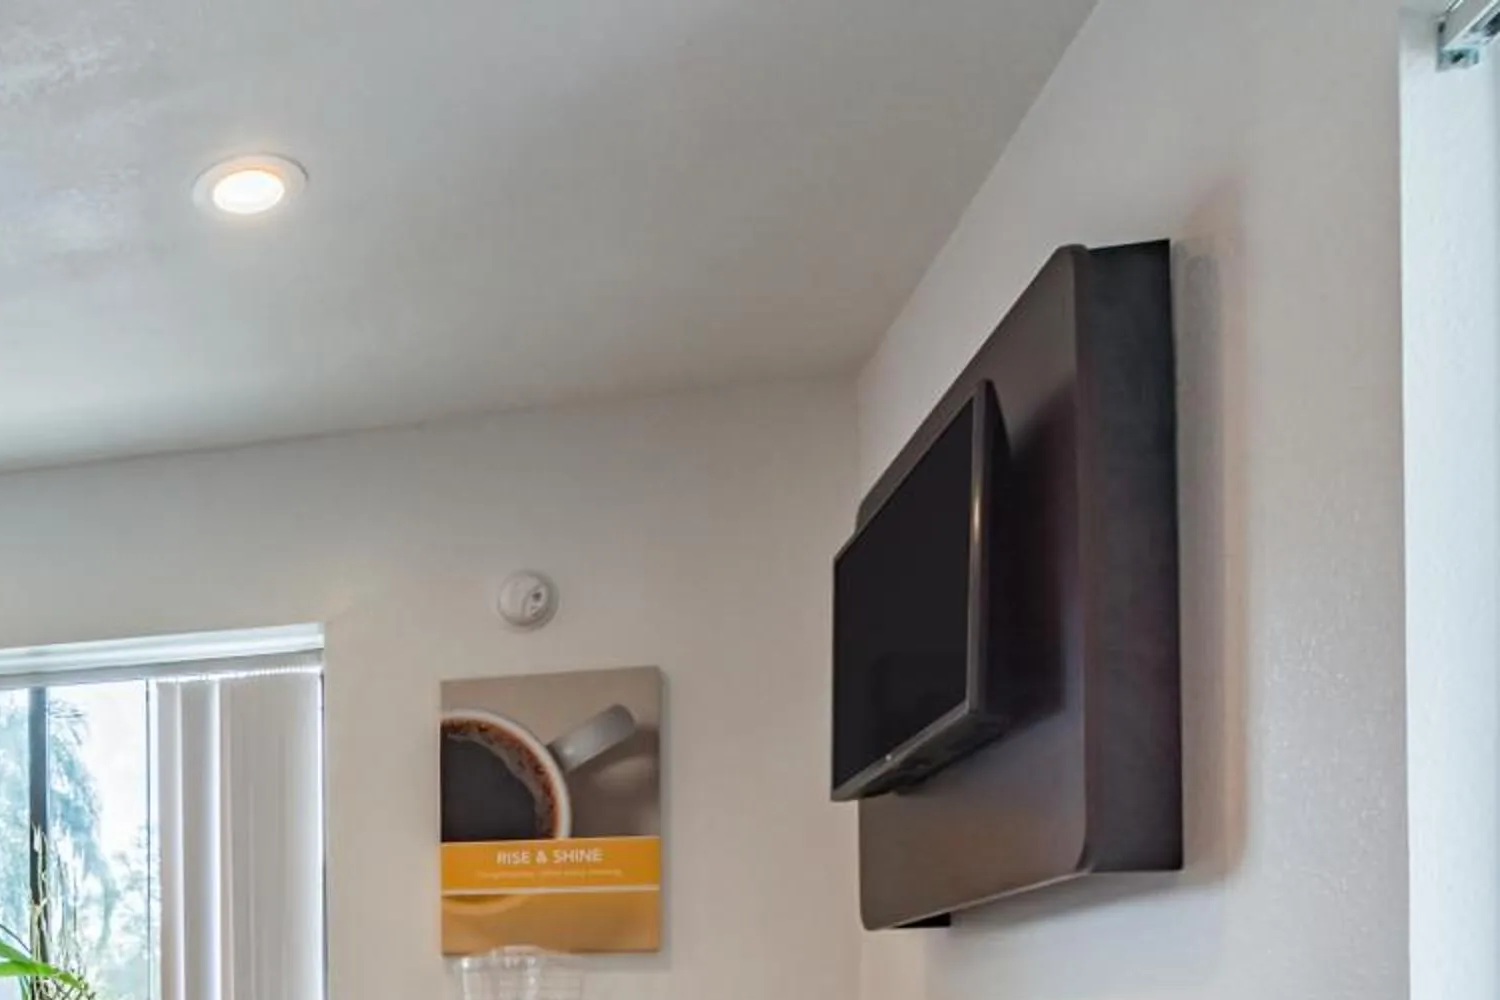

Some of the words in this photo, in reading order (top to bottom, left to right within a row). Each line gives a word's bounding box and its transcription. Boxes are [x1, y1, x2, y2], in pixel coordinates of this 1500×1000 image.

[496, 850, 531, 865] RISE
[535, 850, 548, 864] &
[552, 847, 604, 864] SHINE
